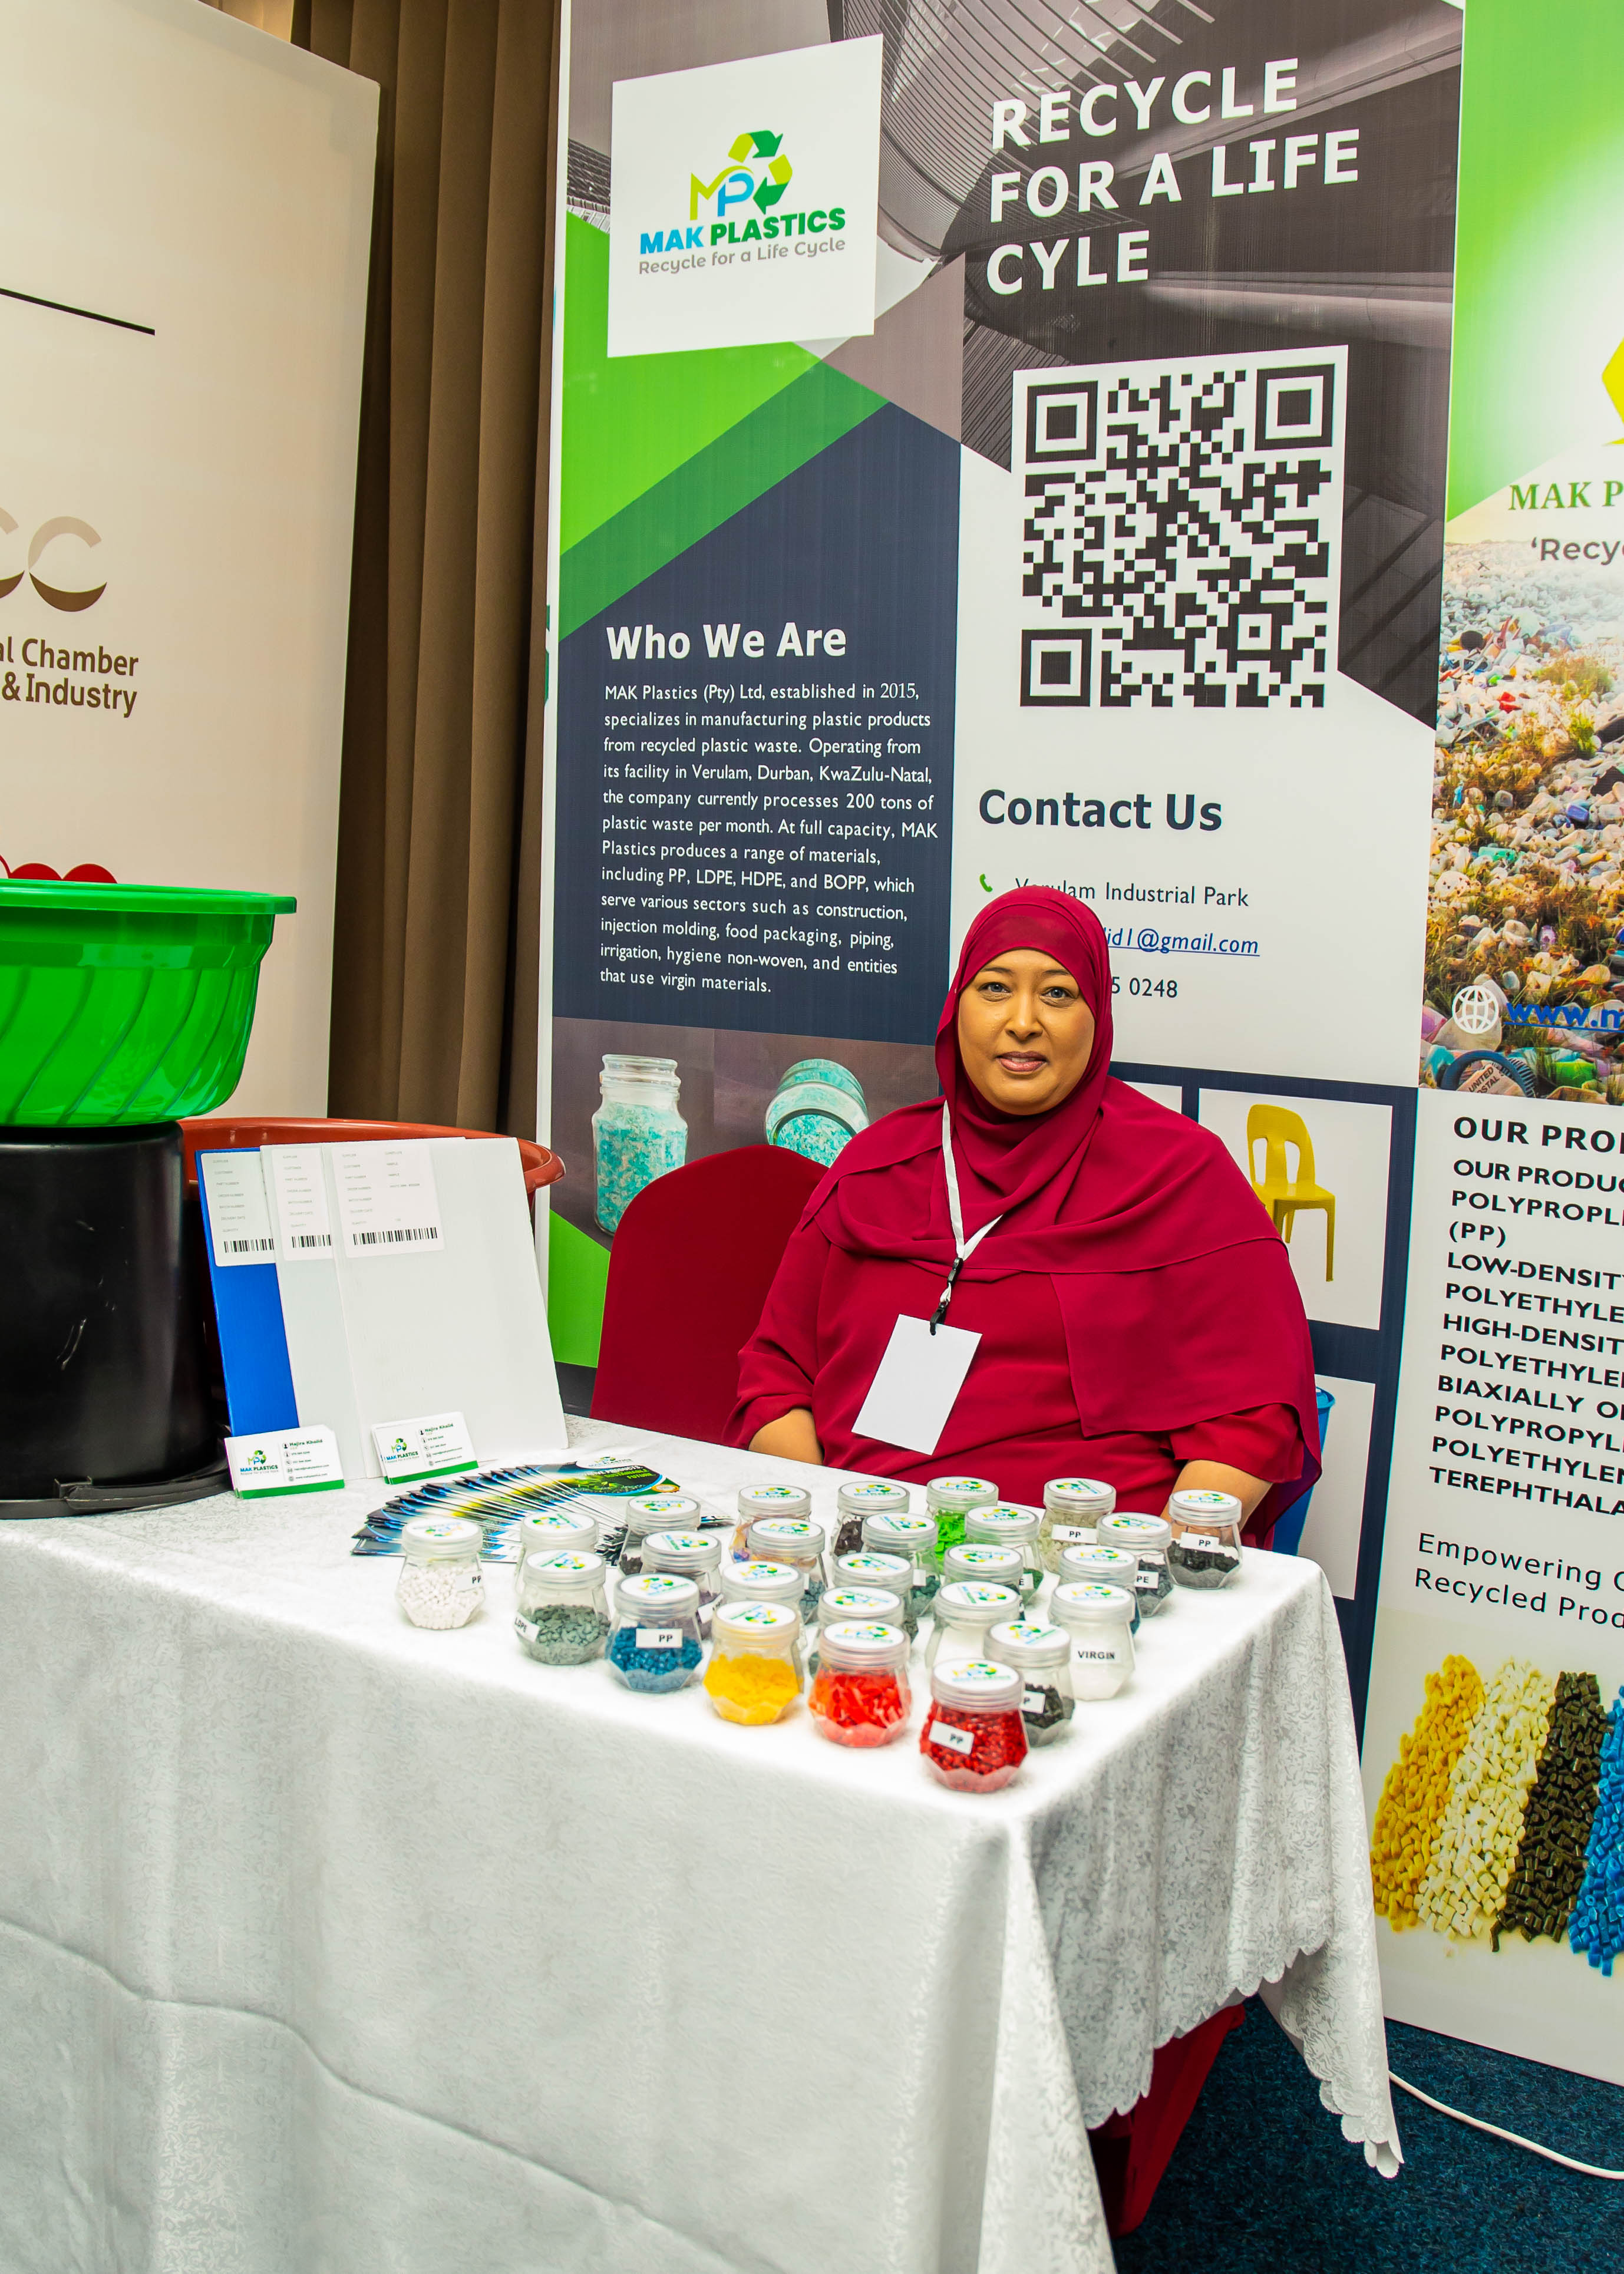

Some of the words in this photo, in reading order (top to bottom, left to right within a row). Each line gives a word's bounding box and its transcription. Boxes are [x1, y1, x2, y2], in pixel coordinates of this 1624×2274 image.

[992, 58, 1298, 149] RECYCLE
[991, 160, 1119, 223] FOR
[1138, 152, 1182, 206] A
[1212, 128, 1359, 197] LIFE
[640, 226, 704, 255] MAK
[710, 207, 846, 246] PLASTICS
[639, 255, 706, 275] Recycle
[711, 252, 735, 266] for
[741, 250, 751, 262] a
[757, 245, 788, 260] Life
[794, 237, 846, 258] Cycle
[986, 230, 1150, 295] CYLE
[1508, 481, 1592, 510] MAK
[606, 624, 691, 660] Who
[702, 623, 765, 658] We
[775, 622, 847, 657] Are
[21, 638, 138, 676] Chamber
[2, 671, 20, 701] &
[26, 673, 137, 718] Industry
[605, 685, 638, 700] MAK
[642, 684, 698, 700] Plastics
[703, 684, 735, 704] (Pty)
[740, 683, 765, 701] Ltd,
[770, 683, 856, 699] established
[862, 684, 875, 698] in
[880, 682, 919, 701] 2015,
[604, 711, 680, 731] specializes
[685, 712, 697, 726] in
[701, 710, 807, 731] manufacturing
[812, 710, 862, 731] plastic
[867, 710, 931, 731] products
[603, 737, 635, 752] from
[641, 737, 696, 757] recycled
[701, 737, 748, 757] plastic
[754, 740, 802, 753] waste.
[808, 737, 882, 758] Operating
[886, 738, 921, 754] from
[603, 764, 620, 778] its
[624, 763, 670, 783] facility
[675, 764, 687, 778] in
[691, 764, 752, 782] Verulam,
[757, 764, 814, 783] Durban,
[819, 765, 932, 784] KwaZulu-Natal,
[603, 788, 624, 804] the
[628, 793, 692, 809] company
[697, 790, 759, 811] currently
[763, 796, 839, 811] processes
[846, 793, 875, 809] 200
[880, 797, 912, 810] tons
[917, 794, 935, 810] of
[979, 789, 1152, 829] Contact
[1166, 793, 1223, 831] Us
[602, 814, 647, 833] plastic
[652, 818, 694, 831] waste
[699, 821, 722, 836] per
[725, 818, 774, 834] month.
[777, 818, 796, 834] At
[799, 818, 823, 835] full
[827, 821, 895, 841] capacity,
[902, 821, 939, 839] MAK
[602, 840, 656, 856] Plastics
[661, 842, 727, 861] produces
[730, 848, 738, 859] a
[744, 848, 785, 865] range
[789, 846, 806, 862] of
[808, 848, 881, 866] materials,
[602, 866, 664, 887] including
[668, 867, 691, 886] PP,
[696, 869, 737, 887] LDPE,
[741, 870, 786, 889] HDPE,
[790, 873, 817, 889] and
[824, 873, 869, 893] BOPP,
[873, 876, 915, 893] which
[1105, 882, 1195, 905] Industrial
[1204, 886, 1249, 907] Park
[601, 895, 636, 907] serve
[641, 895, 688, 910] various
[693, 899, 747, 912] sectors
[752, 899, 786, 915] such
[793, 904, 809, 916] as
[816, 905, 907, 922] construction,
[601, 917, 658, 936] injection
[662, 920, 720, 941] molding,
[725, 922, 758, 939] food
[763, 925, 842, 948] packaging,
[850, 930, 894, 951] piping,
[1104, 928, 1260, 955] id1@gmail.com
[600, 943, 662, 962] irrigation,
[666, 945, 721, 966] hygiene
[727, 953, 807, 971] non-woven,
[813, 955, 840, 971] and
[847, 958, 897, 975] entities
[600, 967, 626, 983] that
[630, 973, 655, 985] use
[660, 972, 696, 991] virgin
[702, 976, 771, 993] materials.
[1129, 977, 1178, 998] 0248
[1454, 1117, 1530, 1144] OUR
[1542, 1124, 1624, 1154] PRO
[1453, 1159, 1510, 1181] OUR
[1452, 1190, 1624, 1226] POLYPROPL
[1449, 1221, 1506, 1248] (PP)
[1448, 1252, 1624, 1291] LOW-DENSIT
[1440, 1344, 1624, 1389] POLYETHYLE
[1438, 1374, 1585, 1414] BIAXIALLY
[1435, 1405, 1624, 1453] POLYPROPYL
[1068, 1530, 1081, 1539] PP
[1199, 1539, 1212, 1547] PP
[1419, 1532, 1602, 1591] Empowering
[471, 1575, 481, 1584] PP
[1415, 1567, 1547, 1613] Recycled
[659, 1633, 674, 1643] PP
[1077, 1650, 1115, 1660] VIRGIN
[949, 1733, 964, 1744] PP
